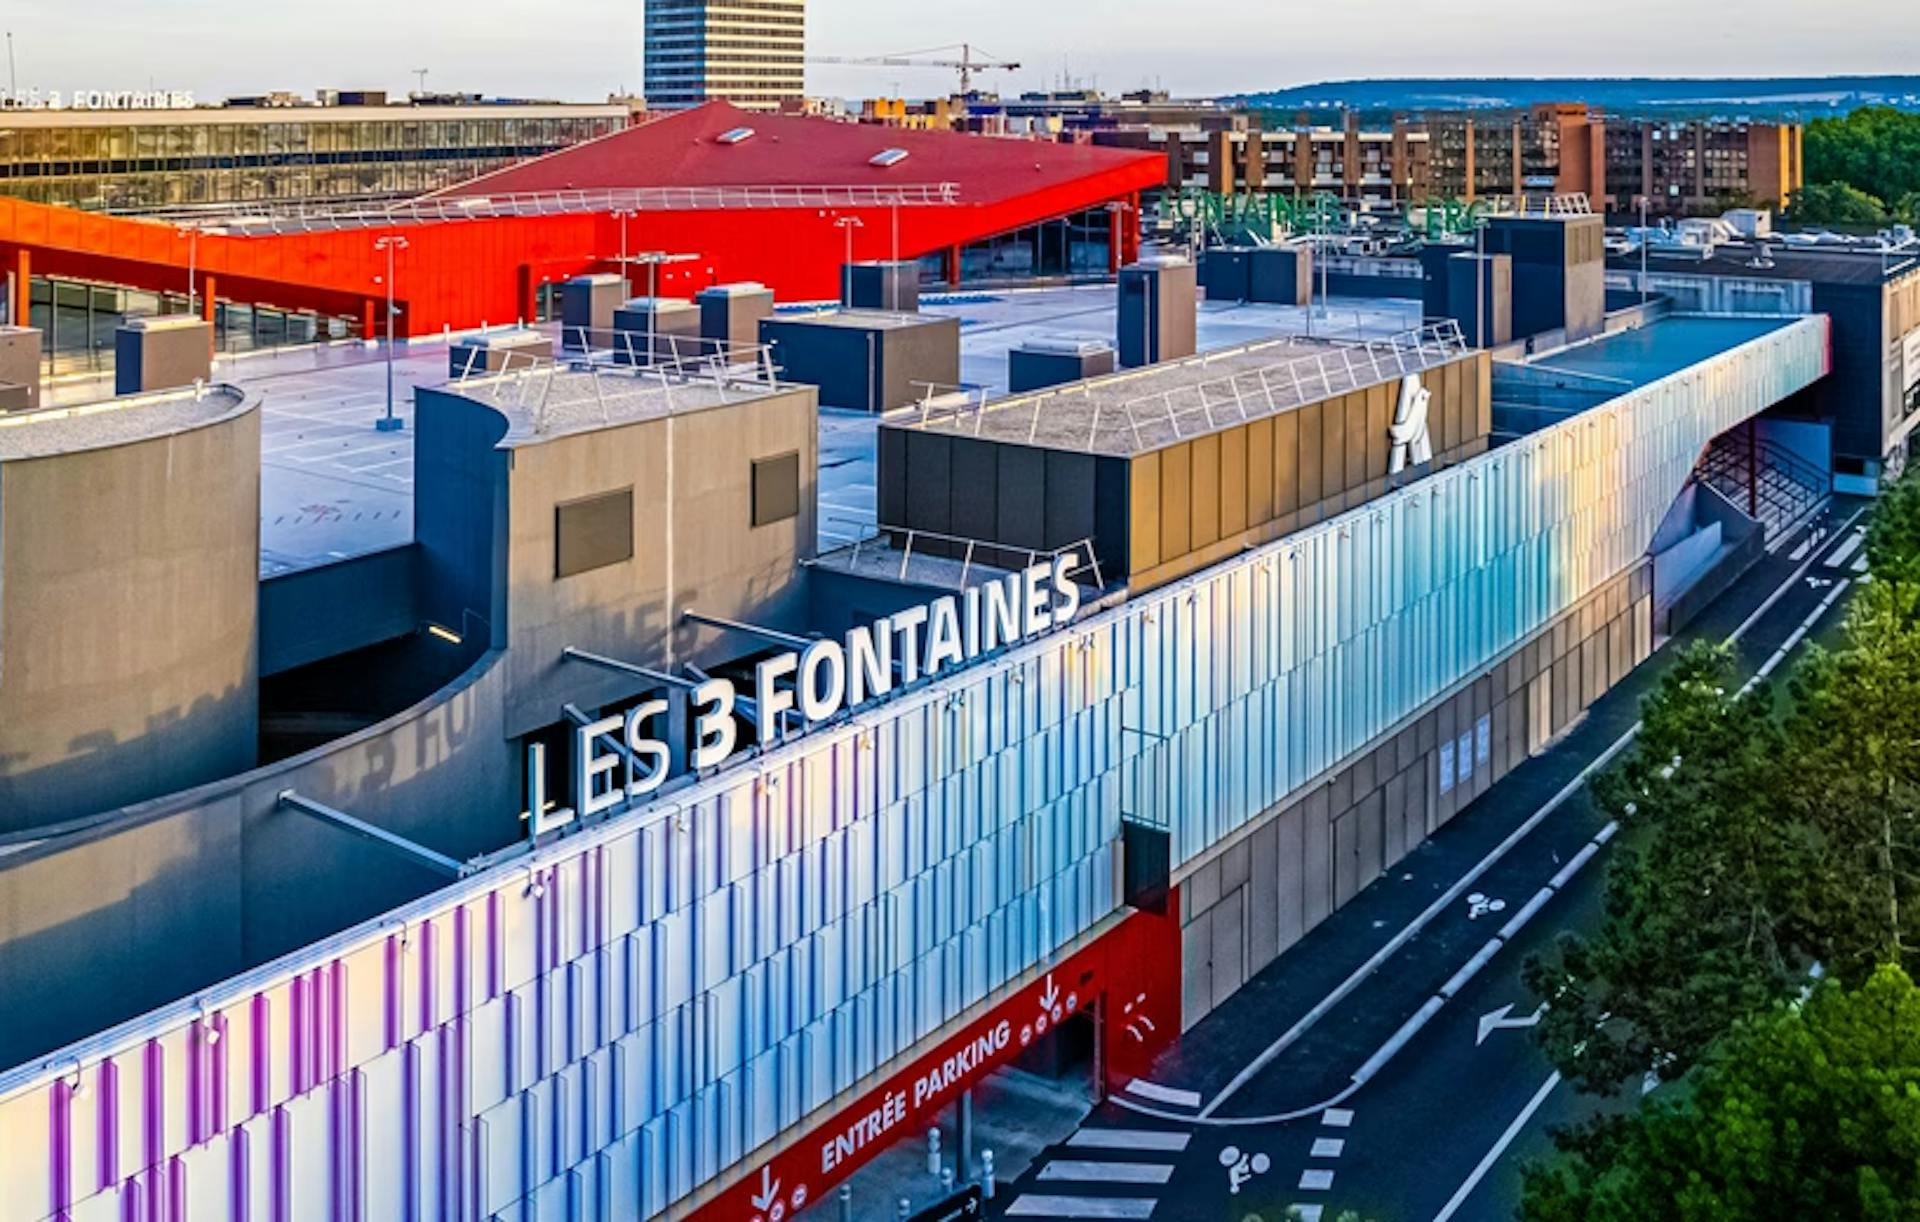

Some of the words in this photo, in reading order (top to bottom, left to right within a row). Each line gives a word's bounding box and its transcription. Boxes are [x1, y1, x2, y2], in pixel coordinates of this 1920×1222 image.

[73, 89, 196, 109] FONTAINES
[529, 699, 670, 836] LES
[692, 677, 738, 768] 3
[757, 553, 1081, 743] FONTAINES
[821, 1090, 907, 1174] ENTRÉE
[913, 1019, 1011, 1109] PARKING
